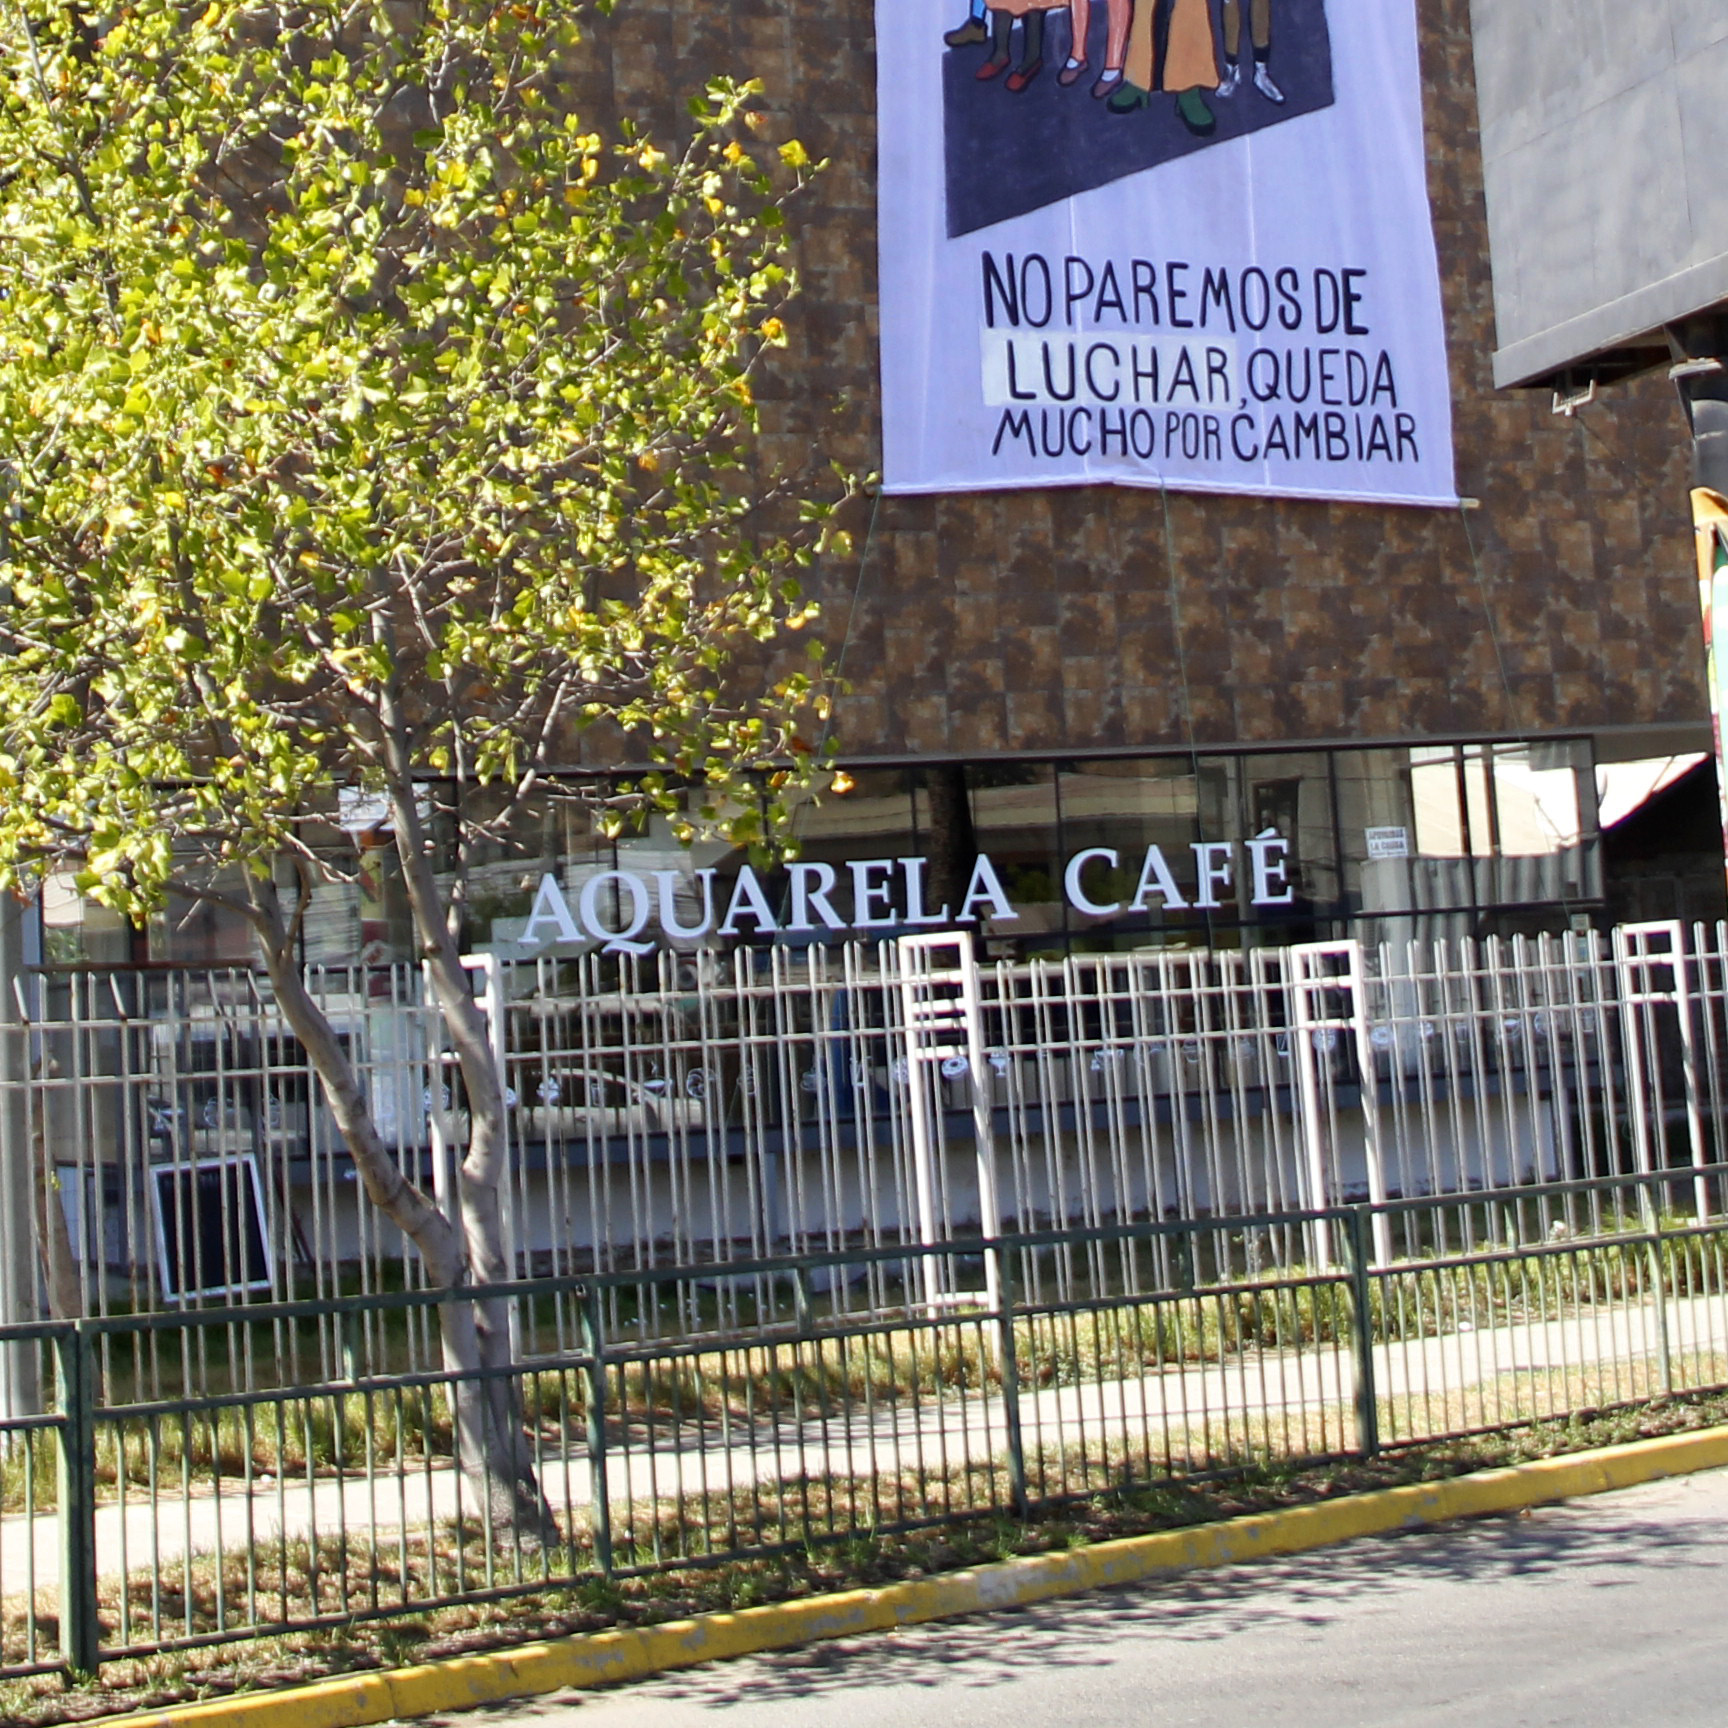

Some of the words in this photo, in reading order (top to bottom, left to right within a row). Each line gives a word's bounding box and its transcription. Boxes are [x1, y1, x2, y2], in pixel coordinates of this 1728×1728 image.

[982, 250, 1053, 328] NO
[1064, 255, 1303, 333] PAREMOS
[1312, 268, 1369, 335] DE
[1246, 347, 1397, 409] QUEDA
[992, 407, 1155, 459] MUCHO
[1165, 412, 1222, 460] POR
[1230, 412, 1419, 463] CAMBIAR
[518, 854, 1018, 956] AQUARELA
[1064, 828, 1294, 916] CAFÉ
